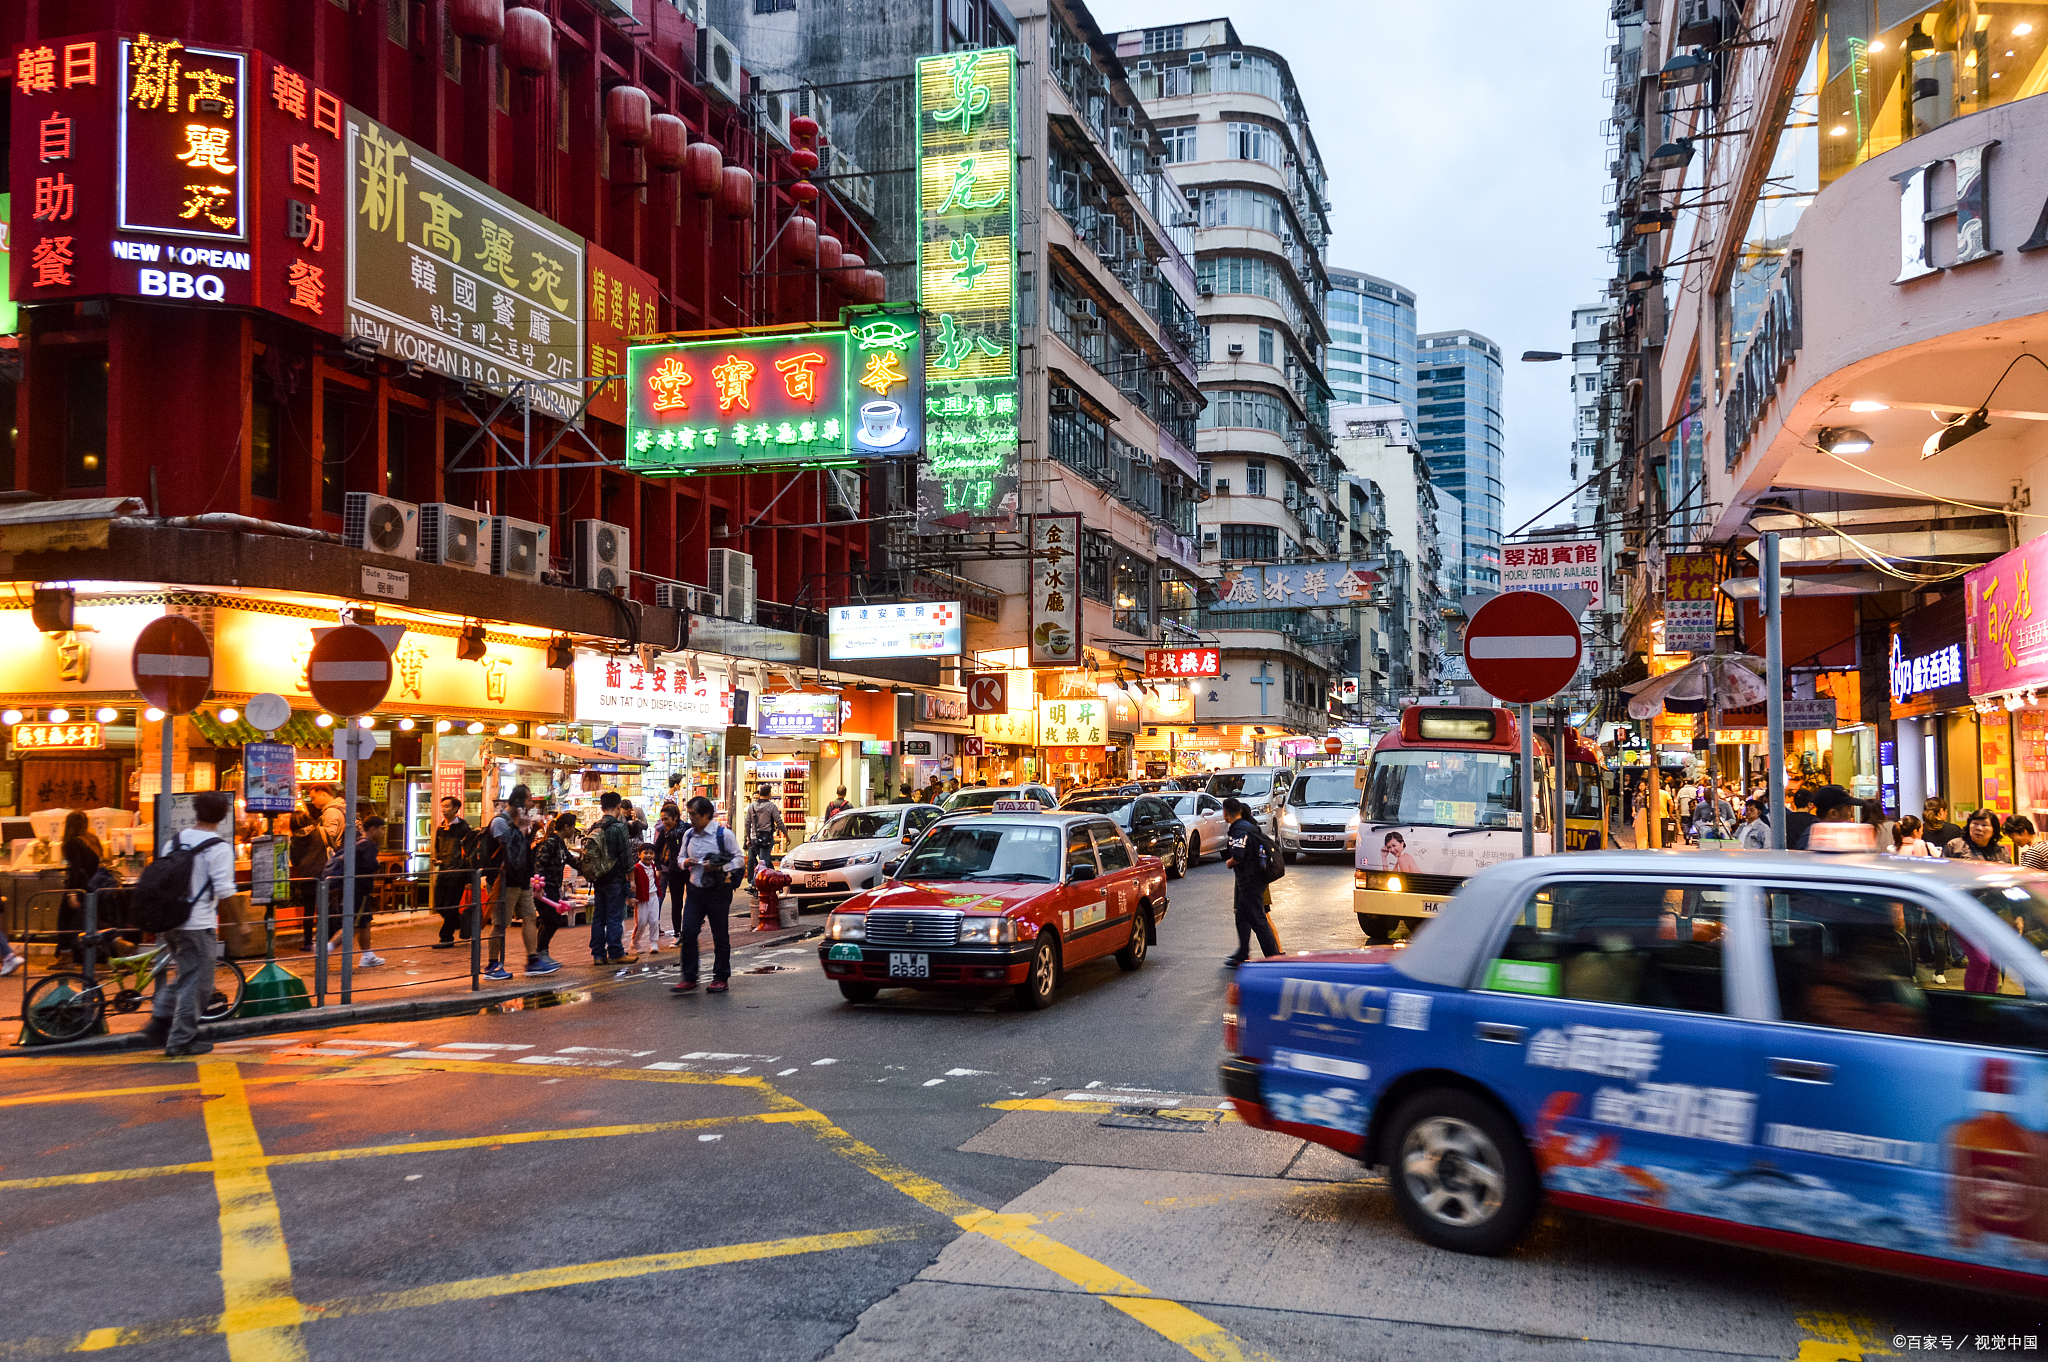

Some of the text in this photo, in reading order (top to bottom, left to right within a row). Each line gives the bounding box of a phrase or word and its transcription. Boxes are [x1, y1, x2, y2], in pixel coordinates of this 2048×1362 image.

[17, 41, 97, 95] 韓日
[273, 65, 342, 140] 韓日
[32, 111, 76, 288] 自助餐
[288, 143, 326, 315] 自助餐
[112, 241, 250, 271] NEW KOREAN
[139, 268, 225, 303] BBQ
[411, 255, 551, 344] 韓國餐廳
[351, 313, 390, 350] NEW
[395, 331, 458, 374] KOREAN
[430, 304, 536, 367] 한국 레스토랑
[547, 352, 574, 379] 2/F
[940, 431, 978, 446] Prime
[978, 426, 1016, 444] Steak
[933, 455, 1001, 472] Restaurant
[943, 480, 991, 508] 1/F
[1504, 544, 1598, 567] 翠湖賓館
[1667, 556, 1714, 578] 翠湖
[366, 568, 406, 583] Bute Street
[1045, 524, 1066, 613] 金華冰廳
[1504, 566, 1598, 580] HOURLY RENTING AVAILABLE
[1667, 578, 1713, 601] 賓館
[840, 605, 925, 620] 新達安藥房
[1160, 652, 1217, 674] 找換店
[600, 694, 617, 706] SUN
[620, 696, 633, 707] TAT
[637, 697, 648, 708] ON
[651, 698, 697, 713] DISPENSARY
[1050, 703, 1096, 726] 明昇
[1045, 726, 1100, 743] 找換店
[997, 801, 1036, 812] TAXI
[841, 946, 849, 955] 5
[900, 954, 917, 965] LW
[892, 965, 927, 977] 2638
